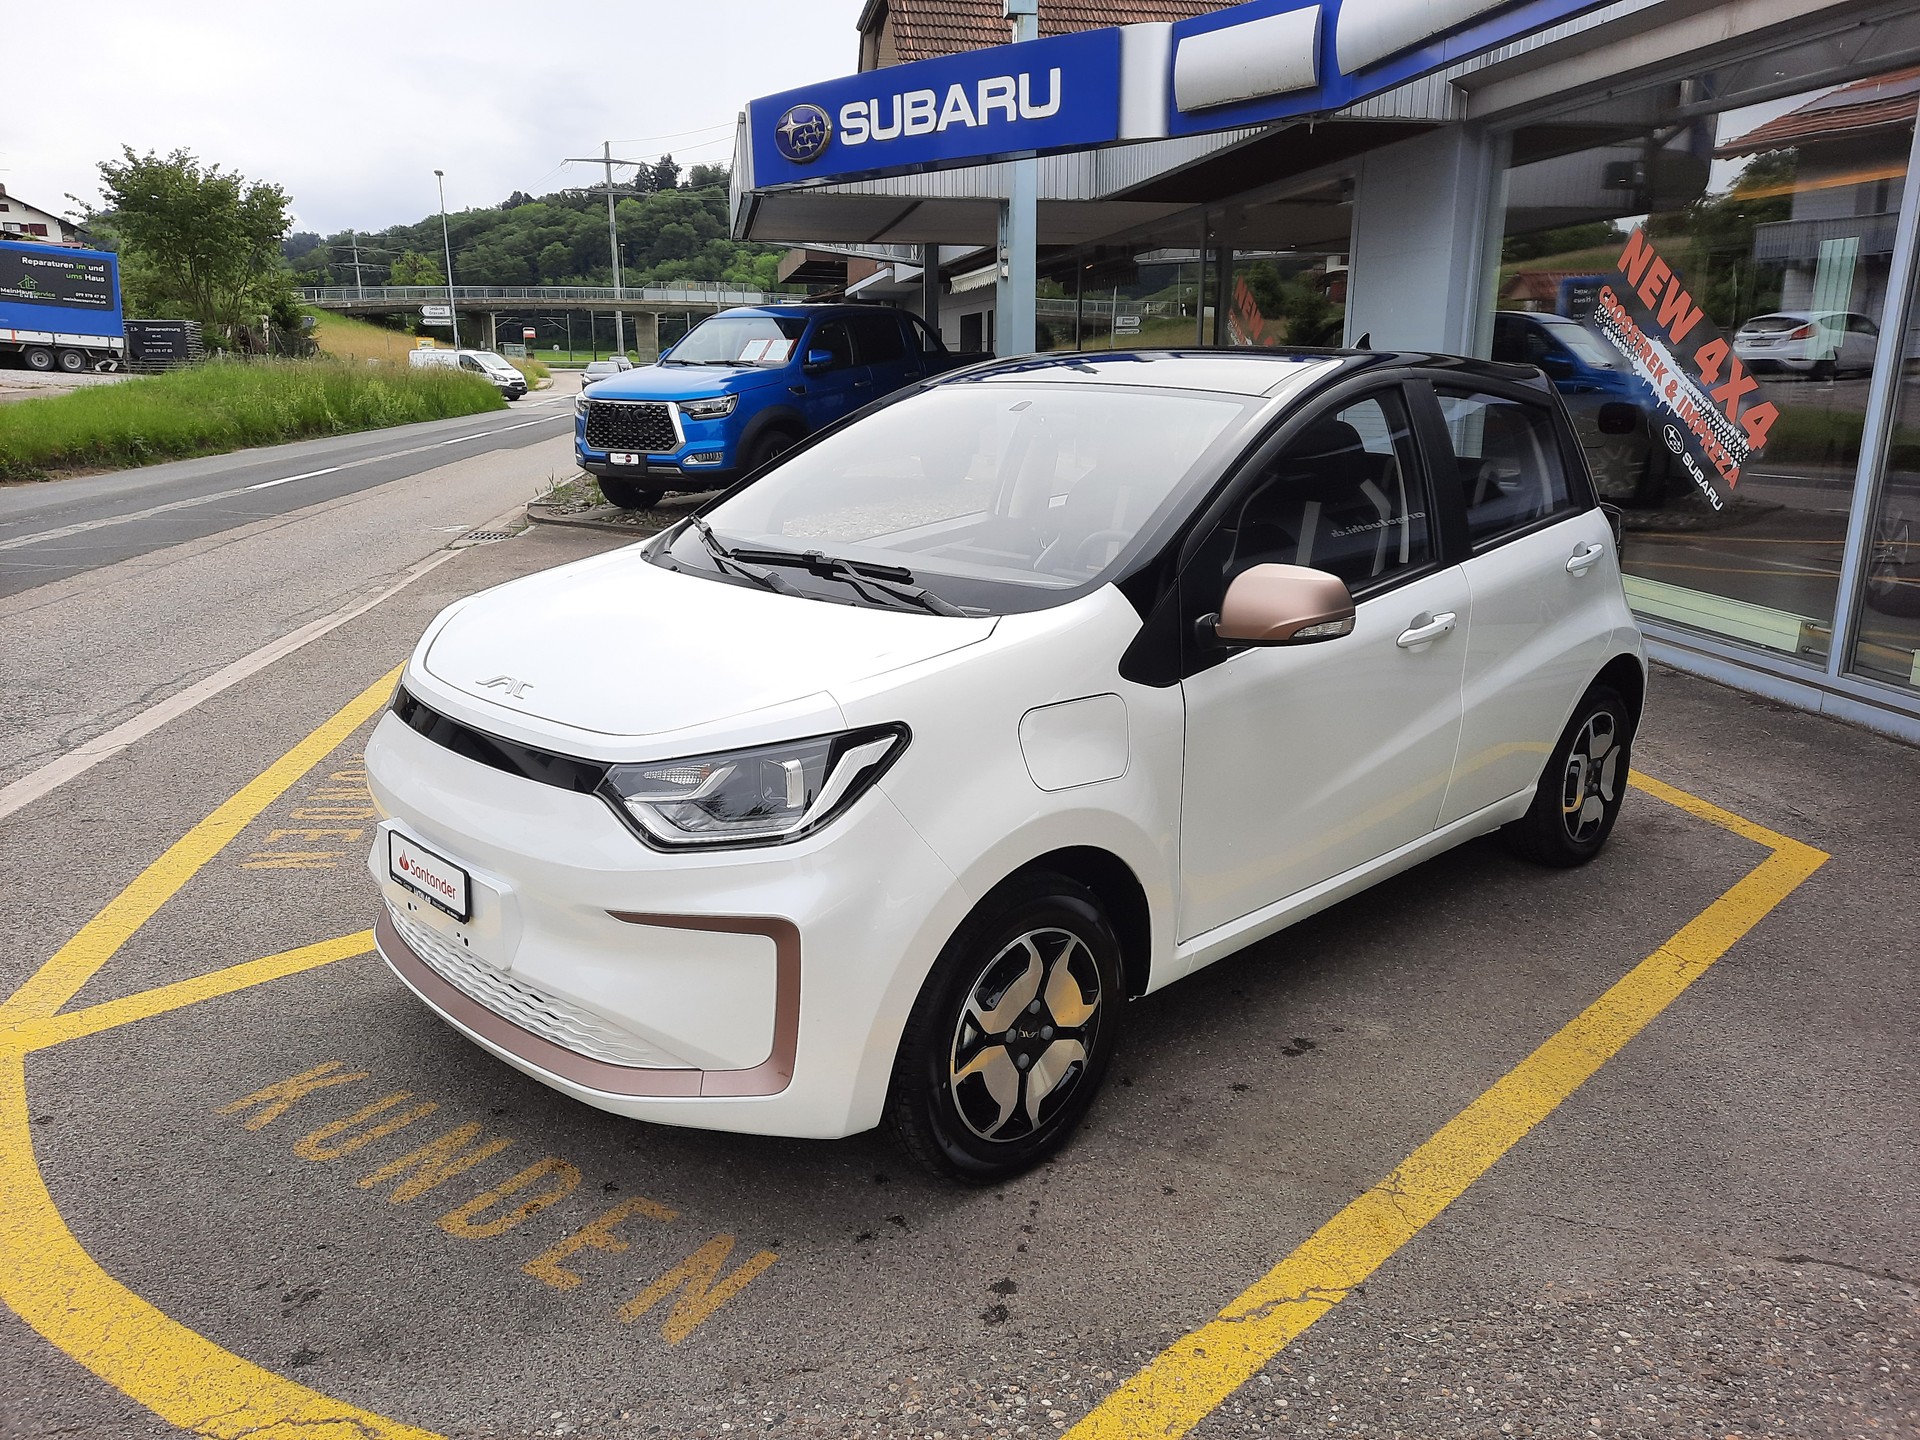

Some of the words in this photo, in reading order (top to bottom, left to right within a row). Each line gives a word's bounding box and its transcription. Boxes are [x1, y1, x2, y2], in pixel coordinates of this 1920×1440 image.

[839, 67, 1062, 146] SUBARU
[21, 256, 74, 269] Reparaturen
[76, 262, 86, 270] im
[84, 274, 105, 283] Haus
[1616, 227, 1705, 346] NEW
[1693, 337, 1780, 451] 4X4
[1599, 285, 1669, 385] CROSSTREK
[1664, 379, 1679, 400] &
[1675, 395, 1741, 491] IMPREZA
[1681, 452, 1725, 512] SUBARU
[410, 858, 457, 900] Santander
[213, 1059, 783, 1347] KUNDEN
